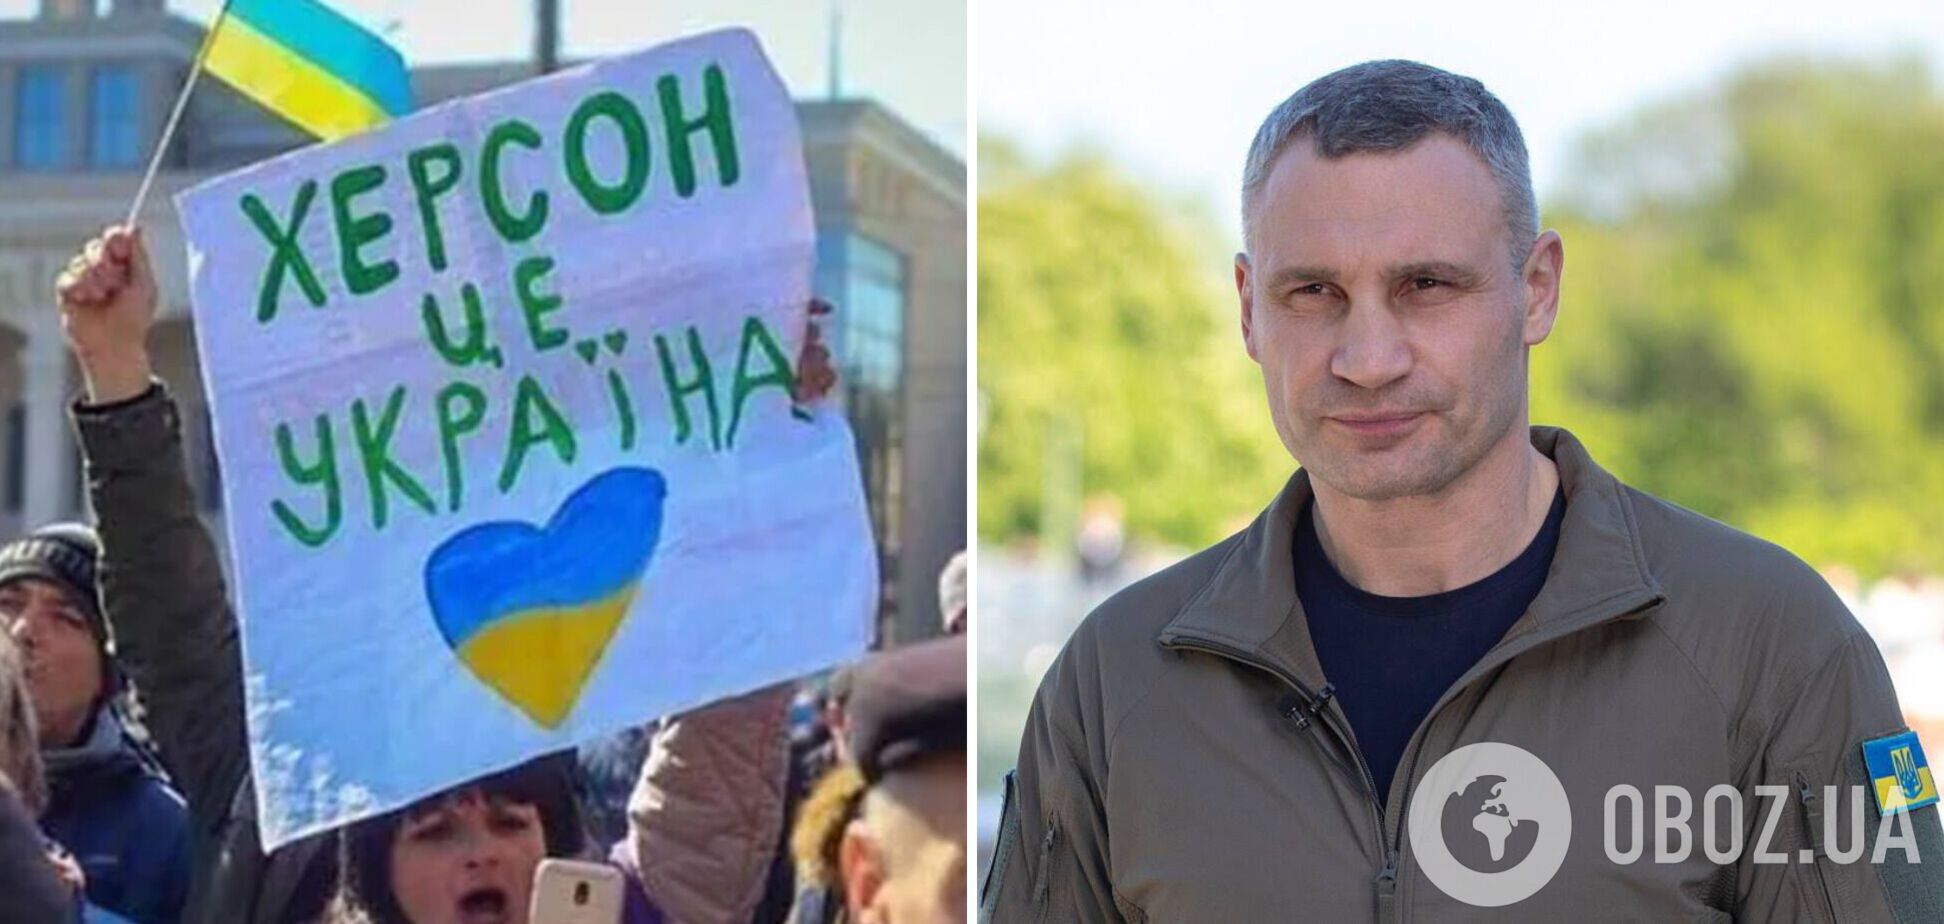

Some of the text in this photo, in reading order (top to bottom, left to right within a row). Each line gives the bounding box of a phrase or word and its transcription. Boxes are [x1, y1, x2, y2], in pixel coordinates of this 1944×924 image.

[240, 63, 740, 323] ХЕРСОН
[423, 256, 570, 369] ЦЕ
[271, 316, 813, 547] УКРАЇНА
